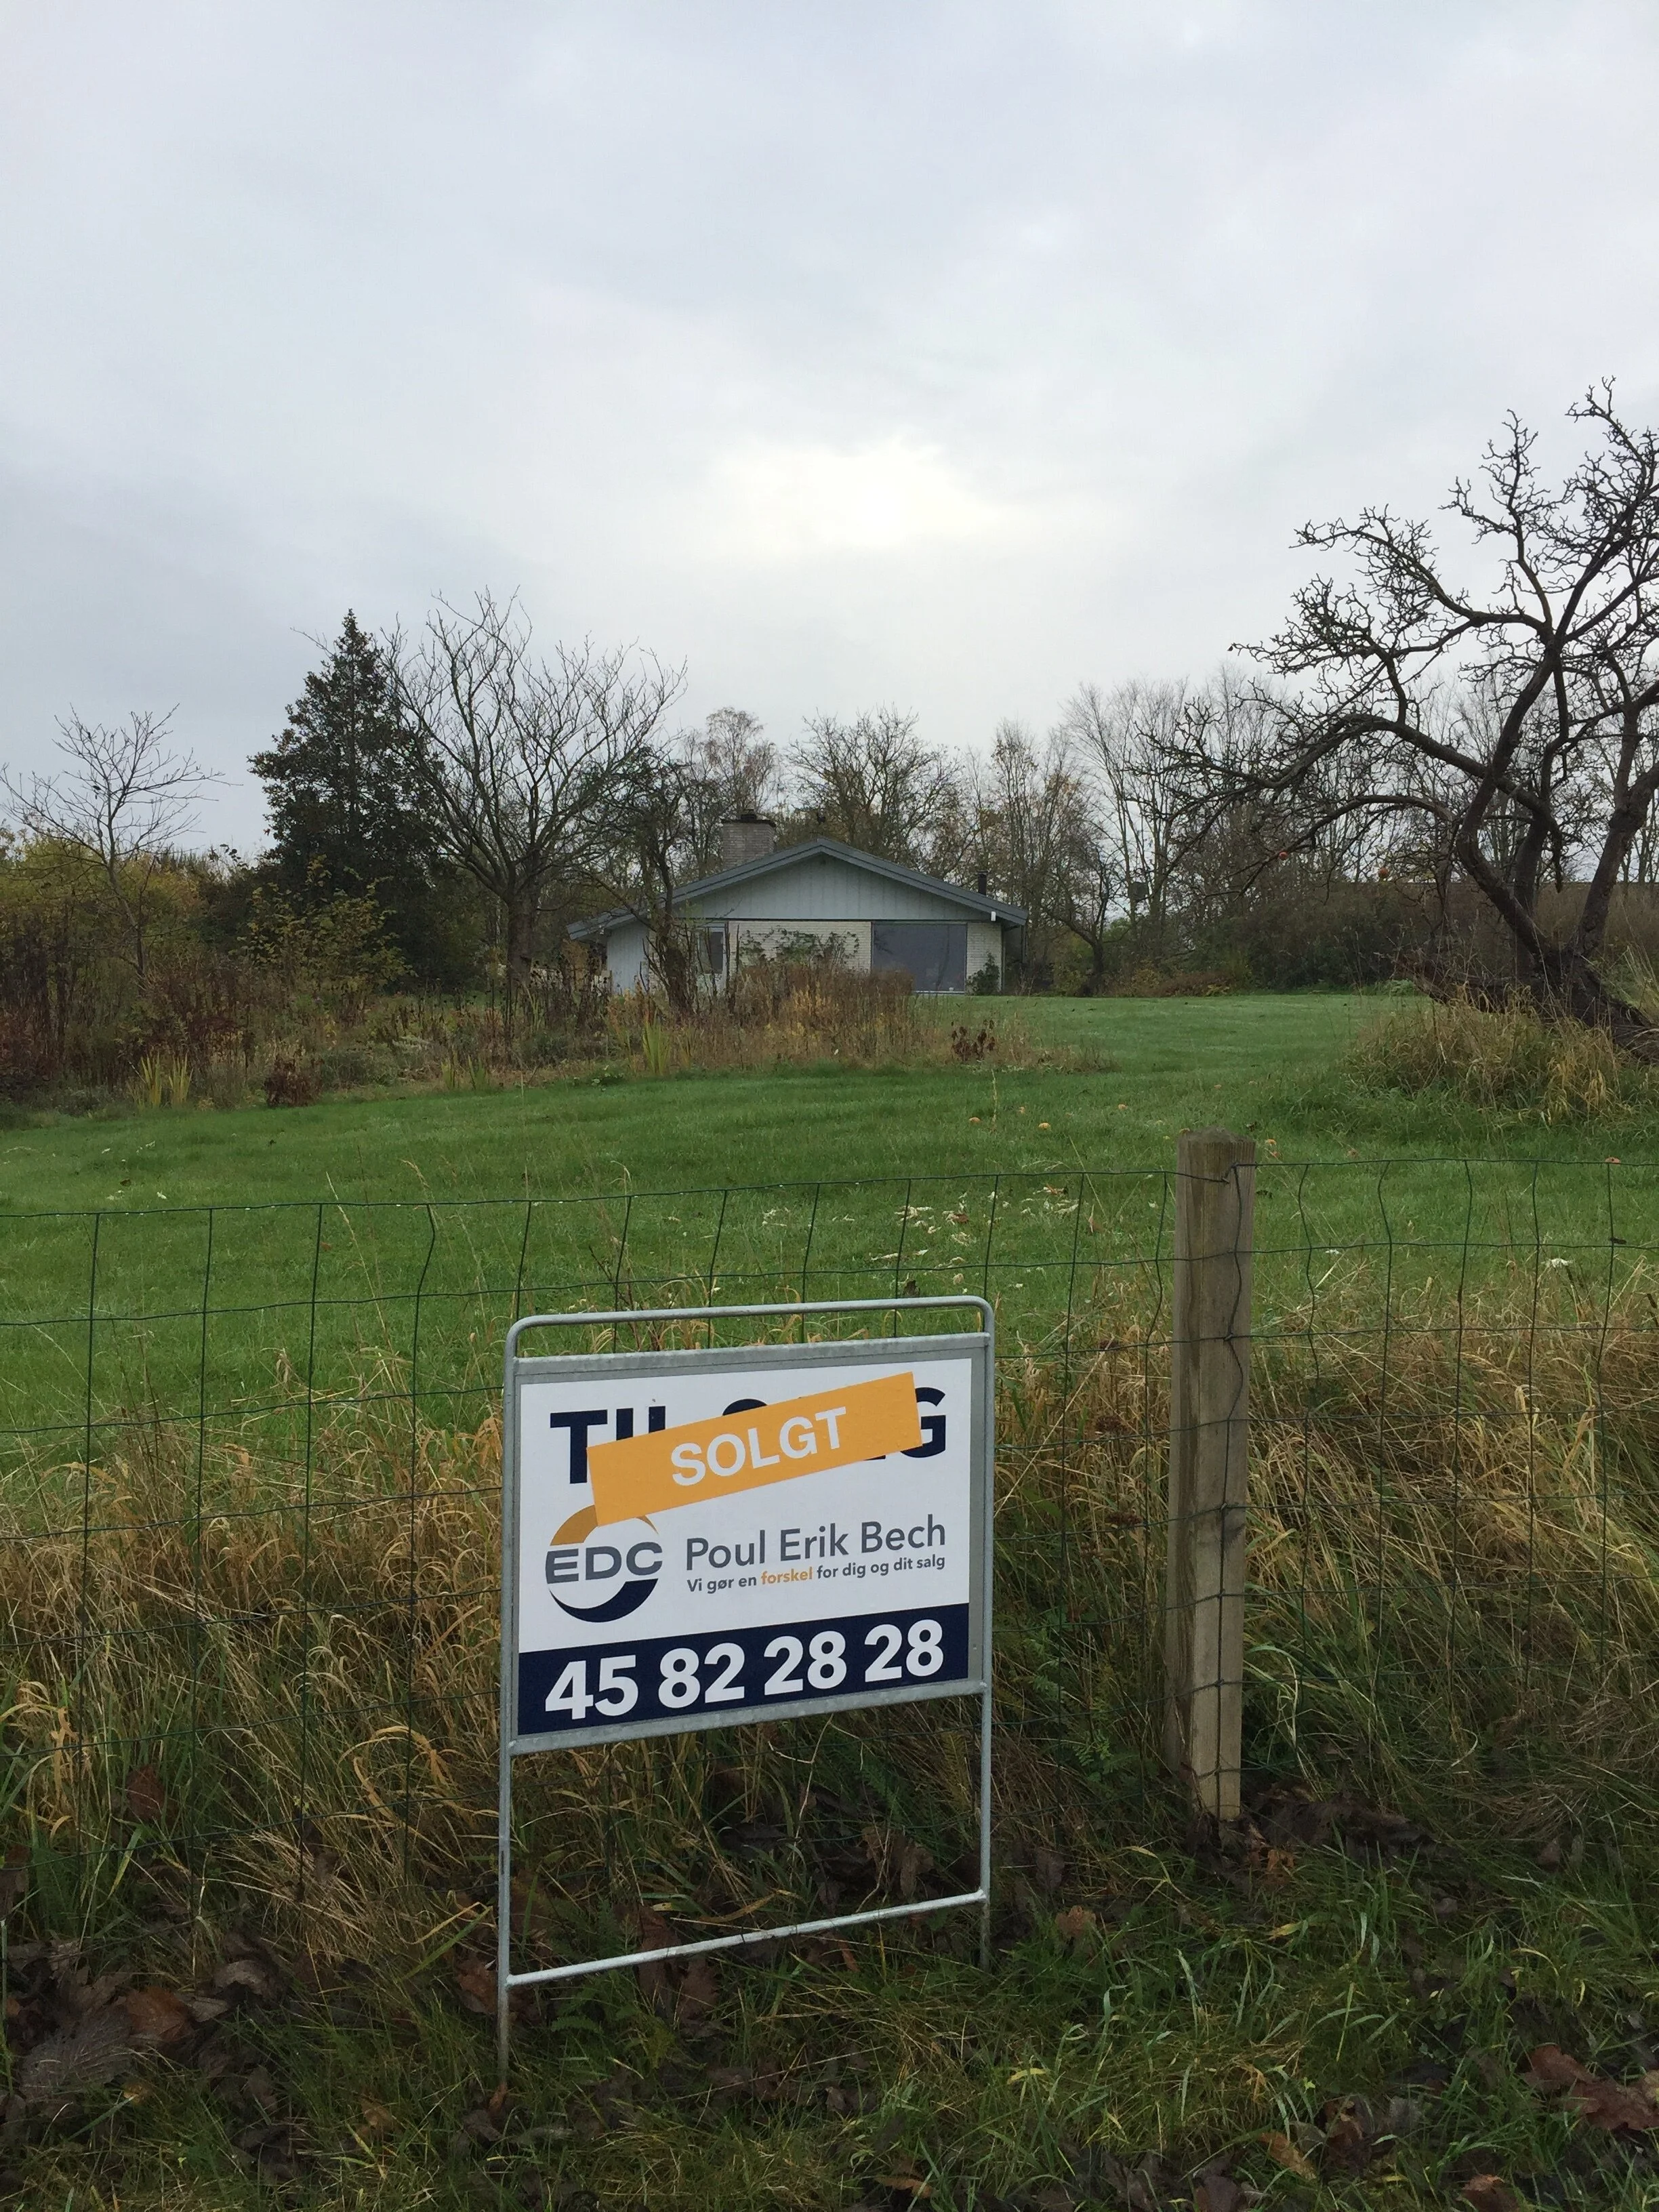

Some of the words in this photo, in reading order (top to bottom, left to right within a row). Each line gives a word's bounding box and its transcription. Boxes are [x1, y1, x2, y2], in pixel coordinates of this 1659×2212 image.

[671, 1406, 846, 1487] SOLGT
[545, 1541, 663, 1584] EDC
[686, 1529, 766, 1571] Poul
[780, 1522, 850, 1562] Erik
[861, 1513, 946, 1554] Bech
[687, 1578, 703, 1593] Vi
[707, 1578, 735, 1595] gør
[738, 1576, 758, 1588] en
[760, 1566, 813, 1585] forskel
[816, 1565, 839, 1579] for
[842, 1562, 866, 1578] dig
[870, 1563, 889, 1576] og
[893, 1557, 914, 1571] dit
[916, 1553, 946, 1570] salg
[545, 1654, 639, 1720] 45
[658, 1642, 745, 1709] 82
[763, 1631, 847, 1696] 28
[865, 1619, 945, 1683] 28
